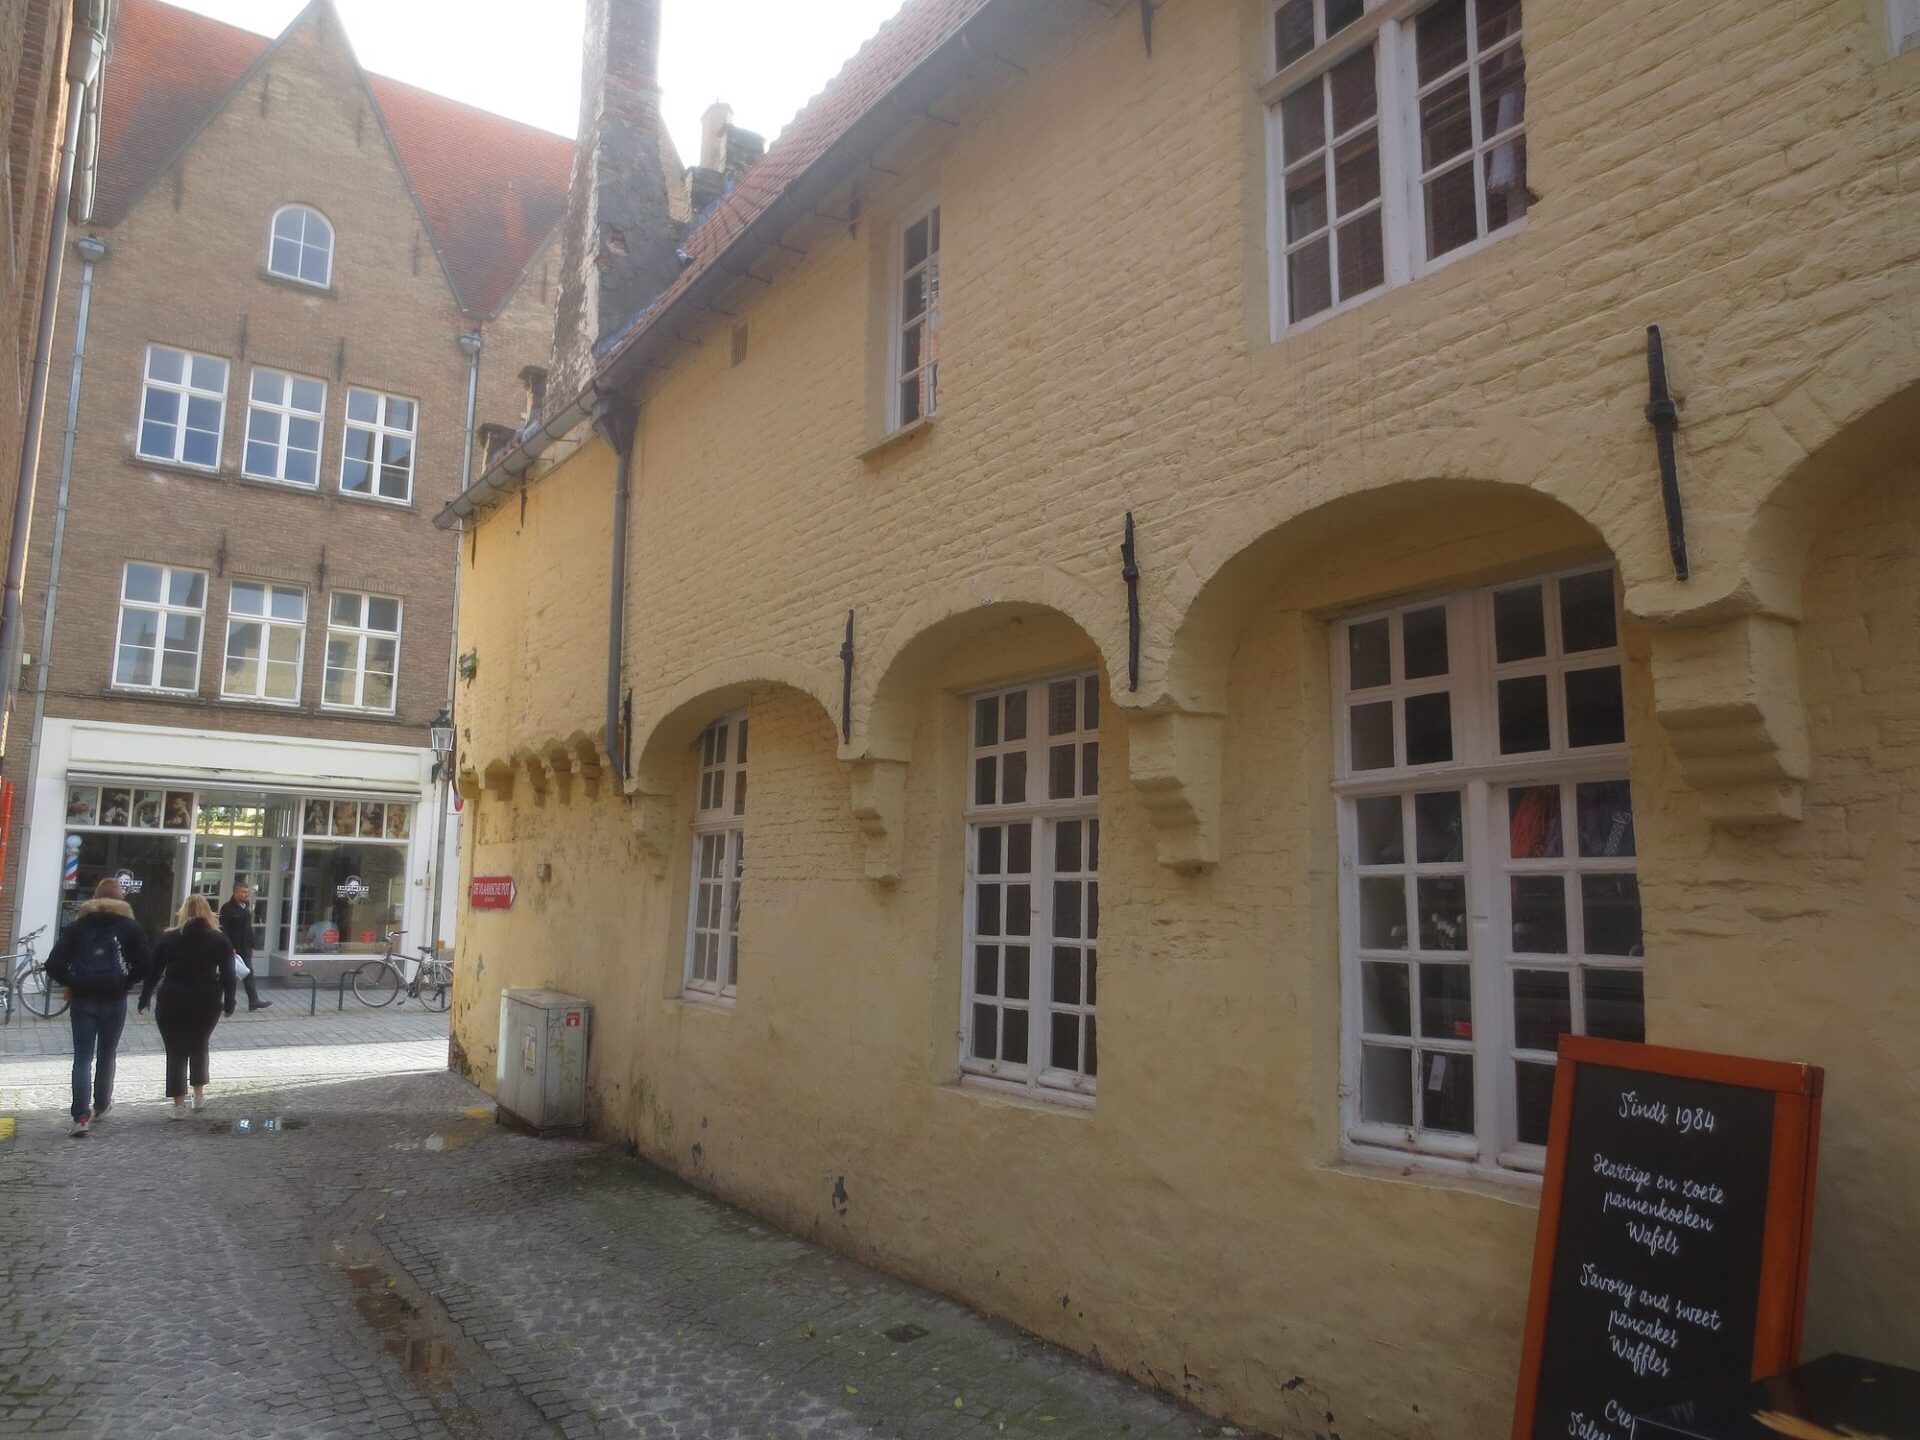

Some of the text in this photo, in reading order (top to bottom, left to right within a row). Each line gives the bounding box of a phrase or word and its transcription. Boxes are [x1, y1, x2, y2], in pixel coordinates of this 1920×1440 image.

[1619, 1091, 1715, 1133] Sinds 1984
[1593, 1153, 1650, 1192] Hartige
[1657, 1175, 1677, 1191] en
[1603, 1191, 1713, 1231] pannenkoeken
[1626, 1221, 1679, 1256] Wafels
[1580, 1263, 1721, 1330] Savory and sweet
[1608, 1310, 1678, 1348] pancakes
[1609, 1335, 1669, 1377] Waffles
